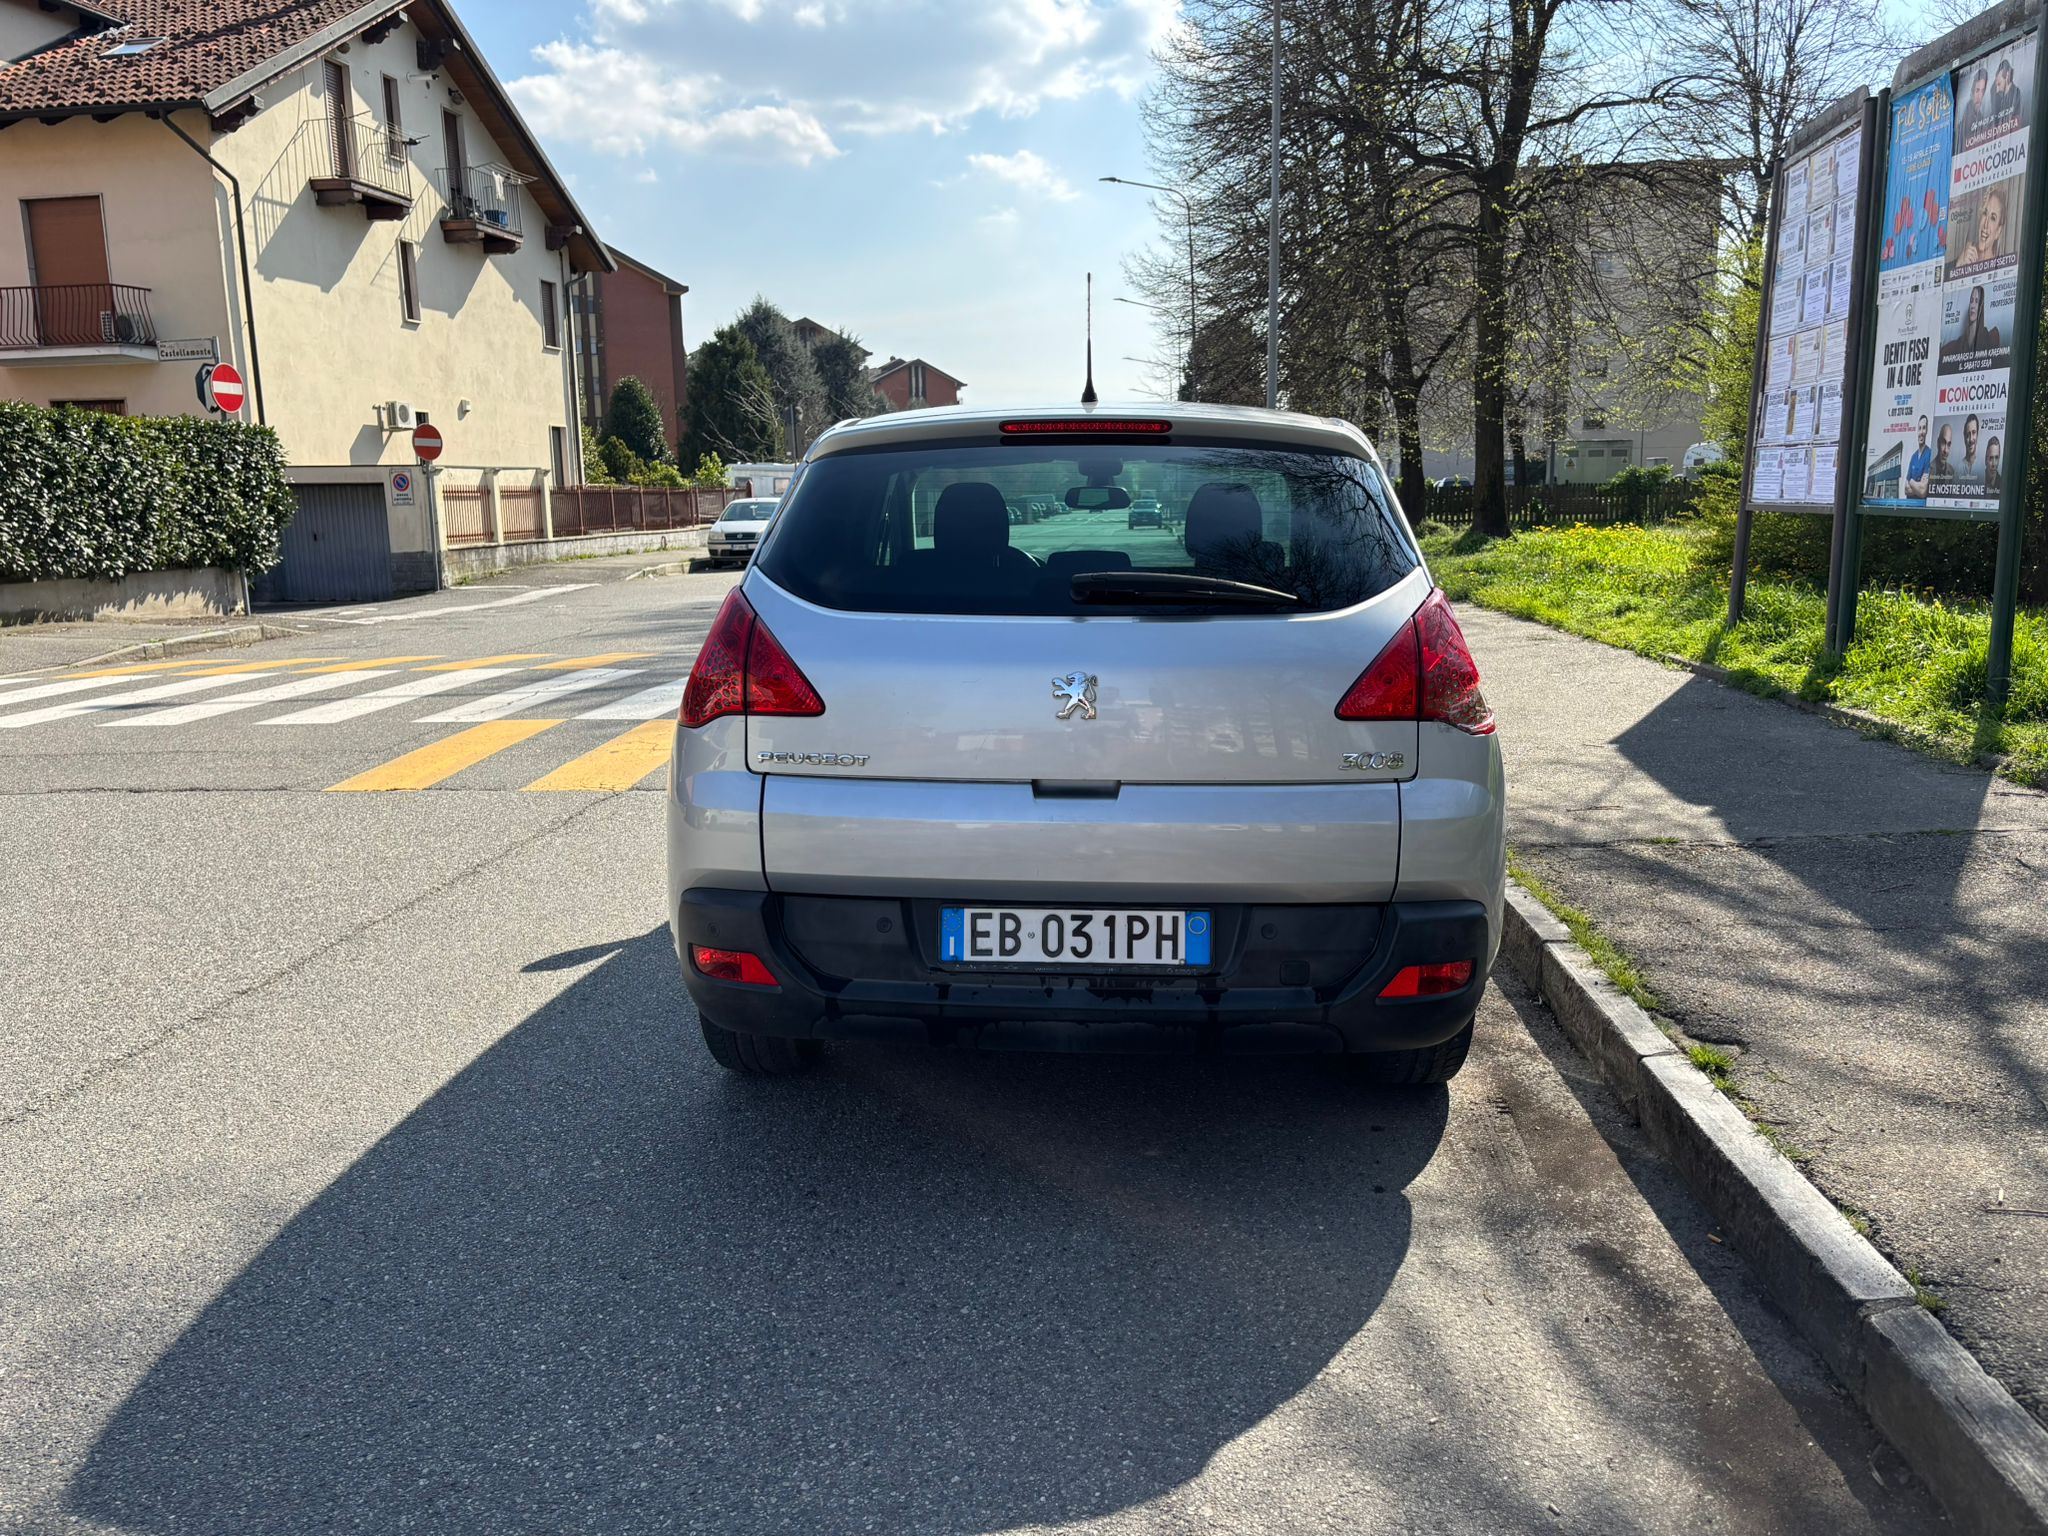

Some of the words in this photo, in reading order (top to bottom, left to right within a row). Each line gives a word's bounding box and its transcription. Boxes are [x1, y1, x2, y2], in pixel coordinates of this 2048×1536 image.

[1962, 142, 2026, 180] CONCORDIA
[160, 348, 212, 358] Castellamonte
[1883, 341, 1907, 366] DENTI
[1908, 336, 1930, 362] FISSI
[1886, 366, 1896, 389] IN
[1897, 366, 1904, 387] 4
[1905, 363, 1922, 387] ORE
[1947, 382, 2007, 403] CONCORDIA
[1981, 419, 1989, 429] 29
[1928, 484, 1935, 494] LE
[1936, 484, 1960, 495] NOSTRE
[1961, 484, 1985, 496] DONNE
[758, 751, 870, 766] PEUGEOT
[1339, 751, 1404, 770] 3008
[970, 912, 1022, 957] EB
[1041, 913, 1179, 960] 031PH
